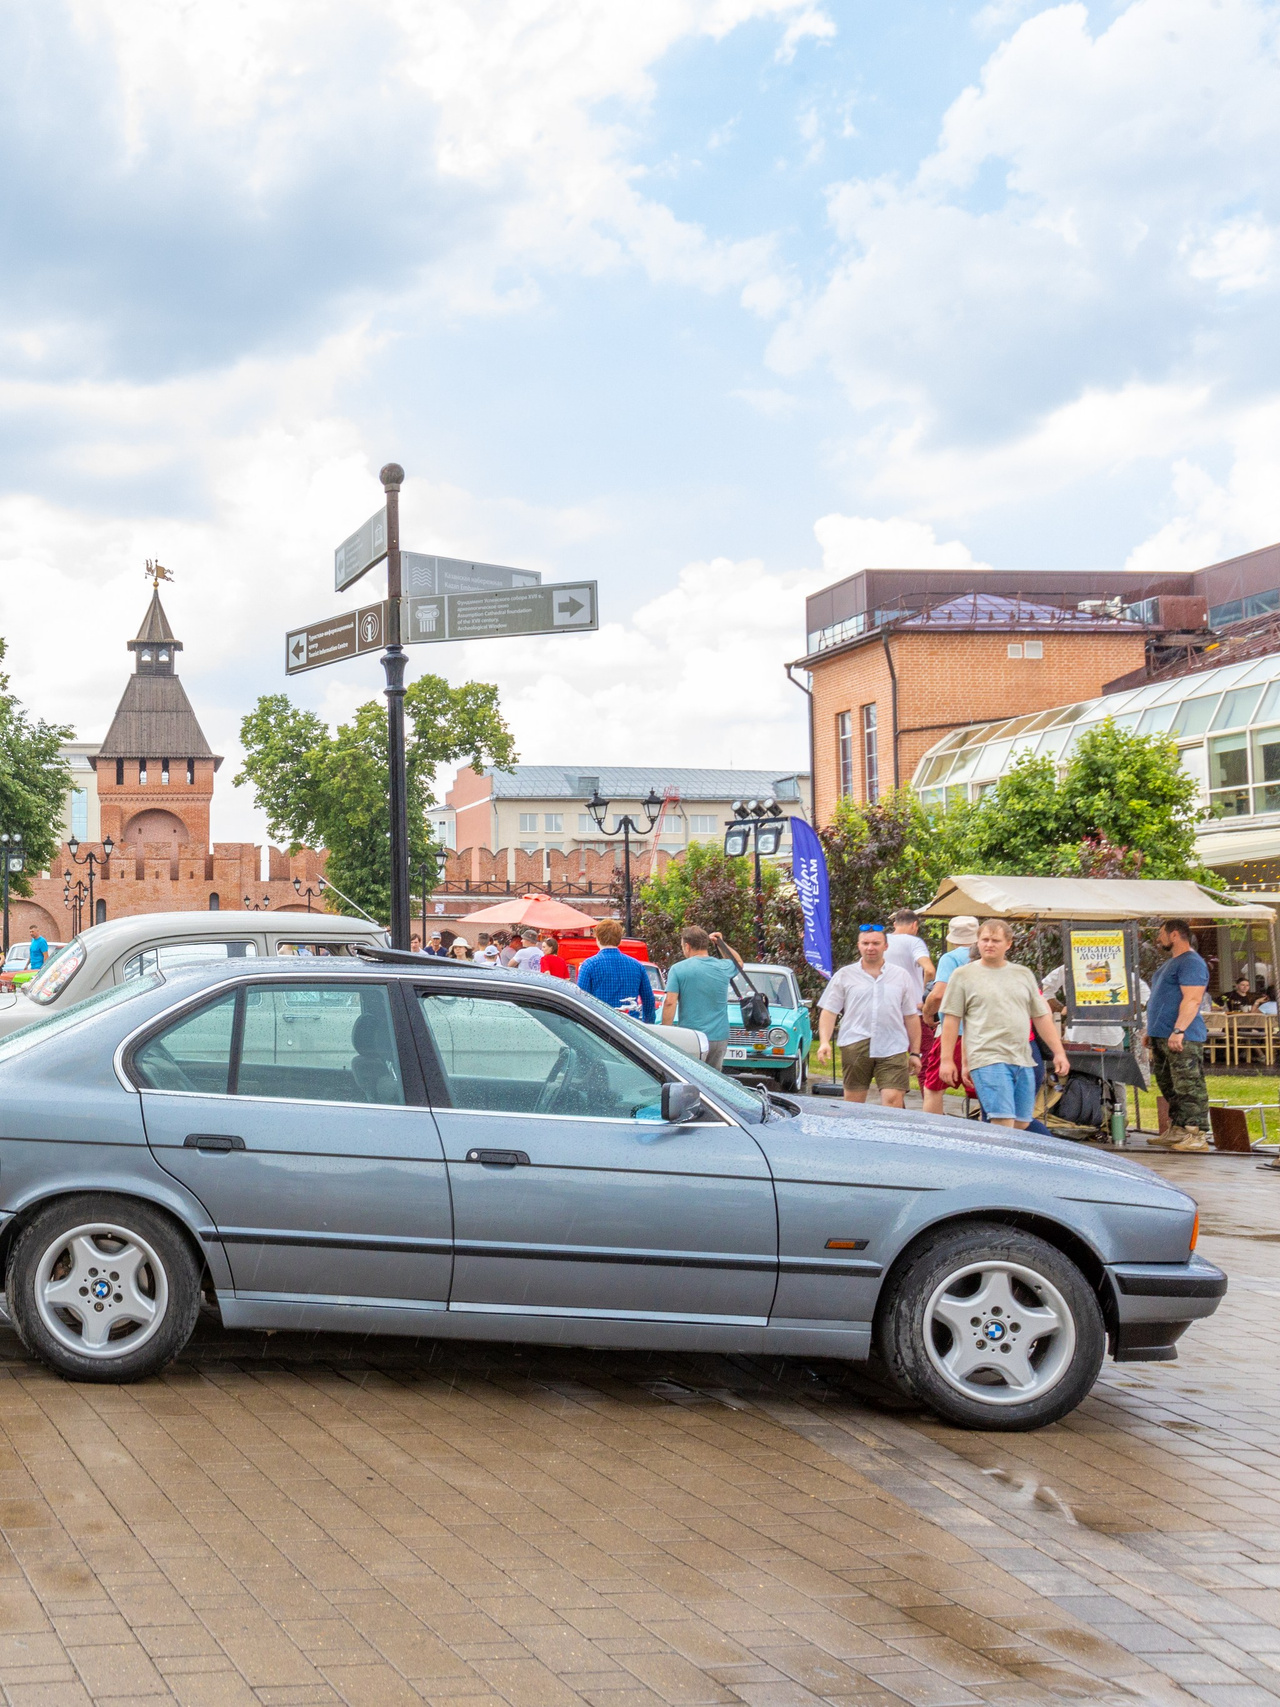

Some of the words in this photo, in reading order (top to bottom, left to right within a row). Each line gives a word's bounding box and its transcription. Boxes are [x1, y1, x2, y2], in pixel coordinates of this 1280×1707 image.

[445, 572, 470, 582] Казанская
[471, 577, 502, 586] набережная
[457, 624, 488, 632] Archeological
[810, 858, 820, 906] TEAM
[1073, 946, 1122, 954] ЧЕКАНКА
[729, 1050, 743, 1058] ТЮ
